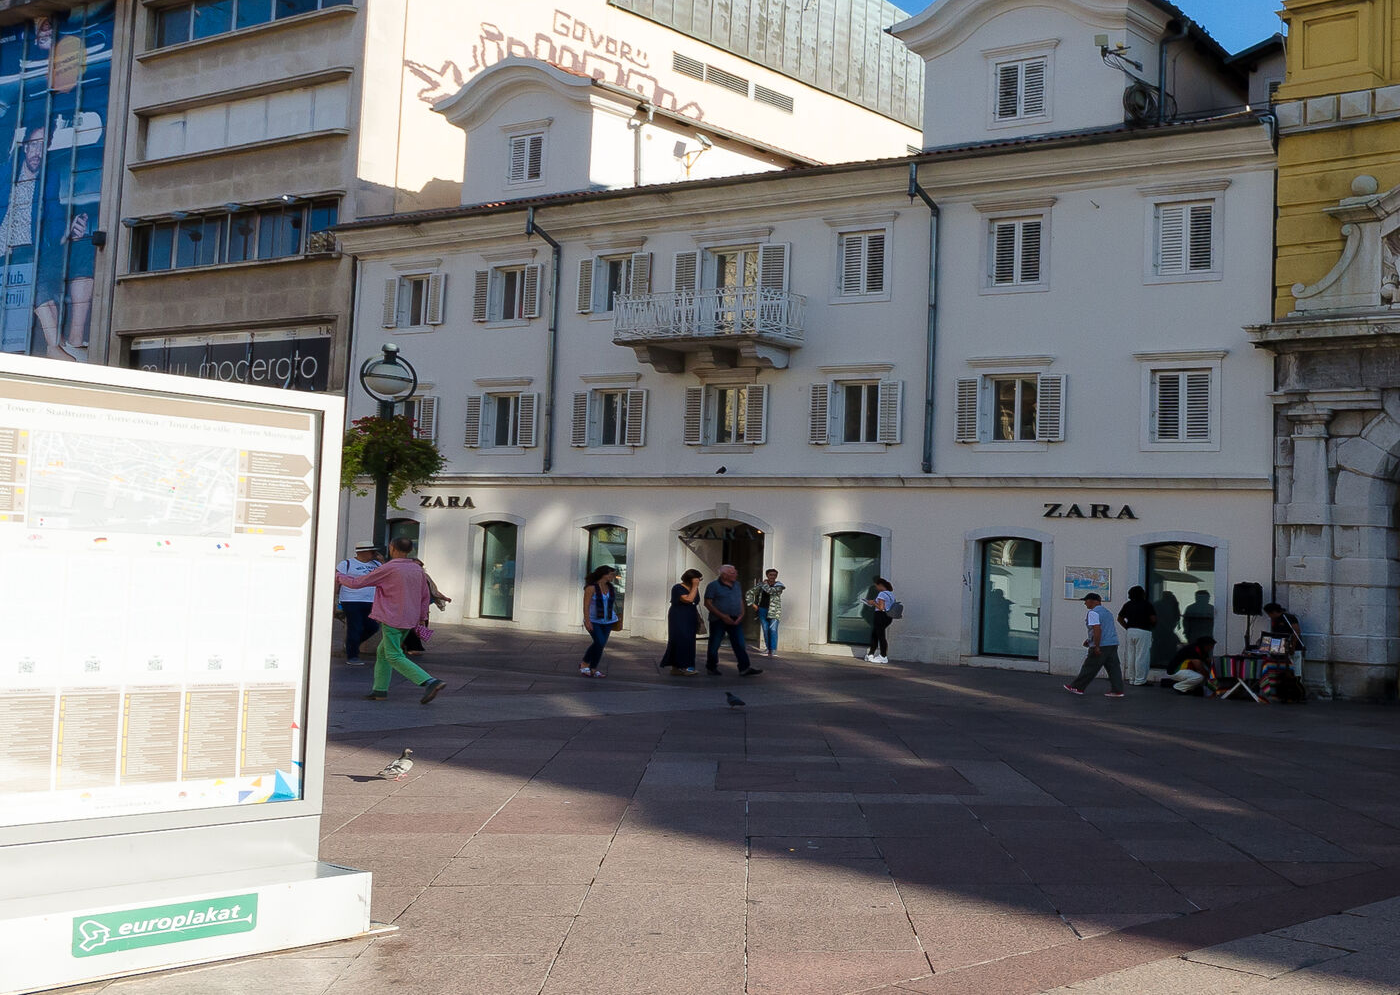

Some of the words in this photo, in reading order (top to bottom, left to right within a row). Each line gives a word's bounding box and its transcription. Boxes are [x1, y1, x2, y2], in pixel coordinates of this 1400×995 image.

[419, 495, 476, 509] ZARA
[1043, 503, 1139, 520] ZARA
[685, 525, 757, 540] ZARA
[118, 904, 241, 935] europlakat
